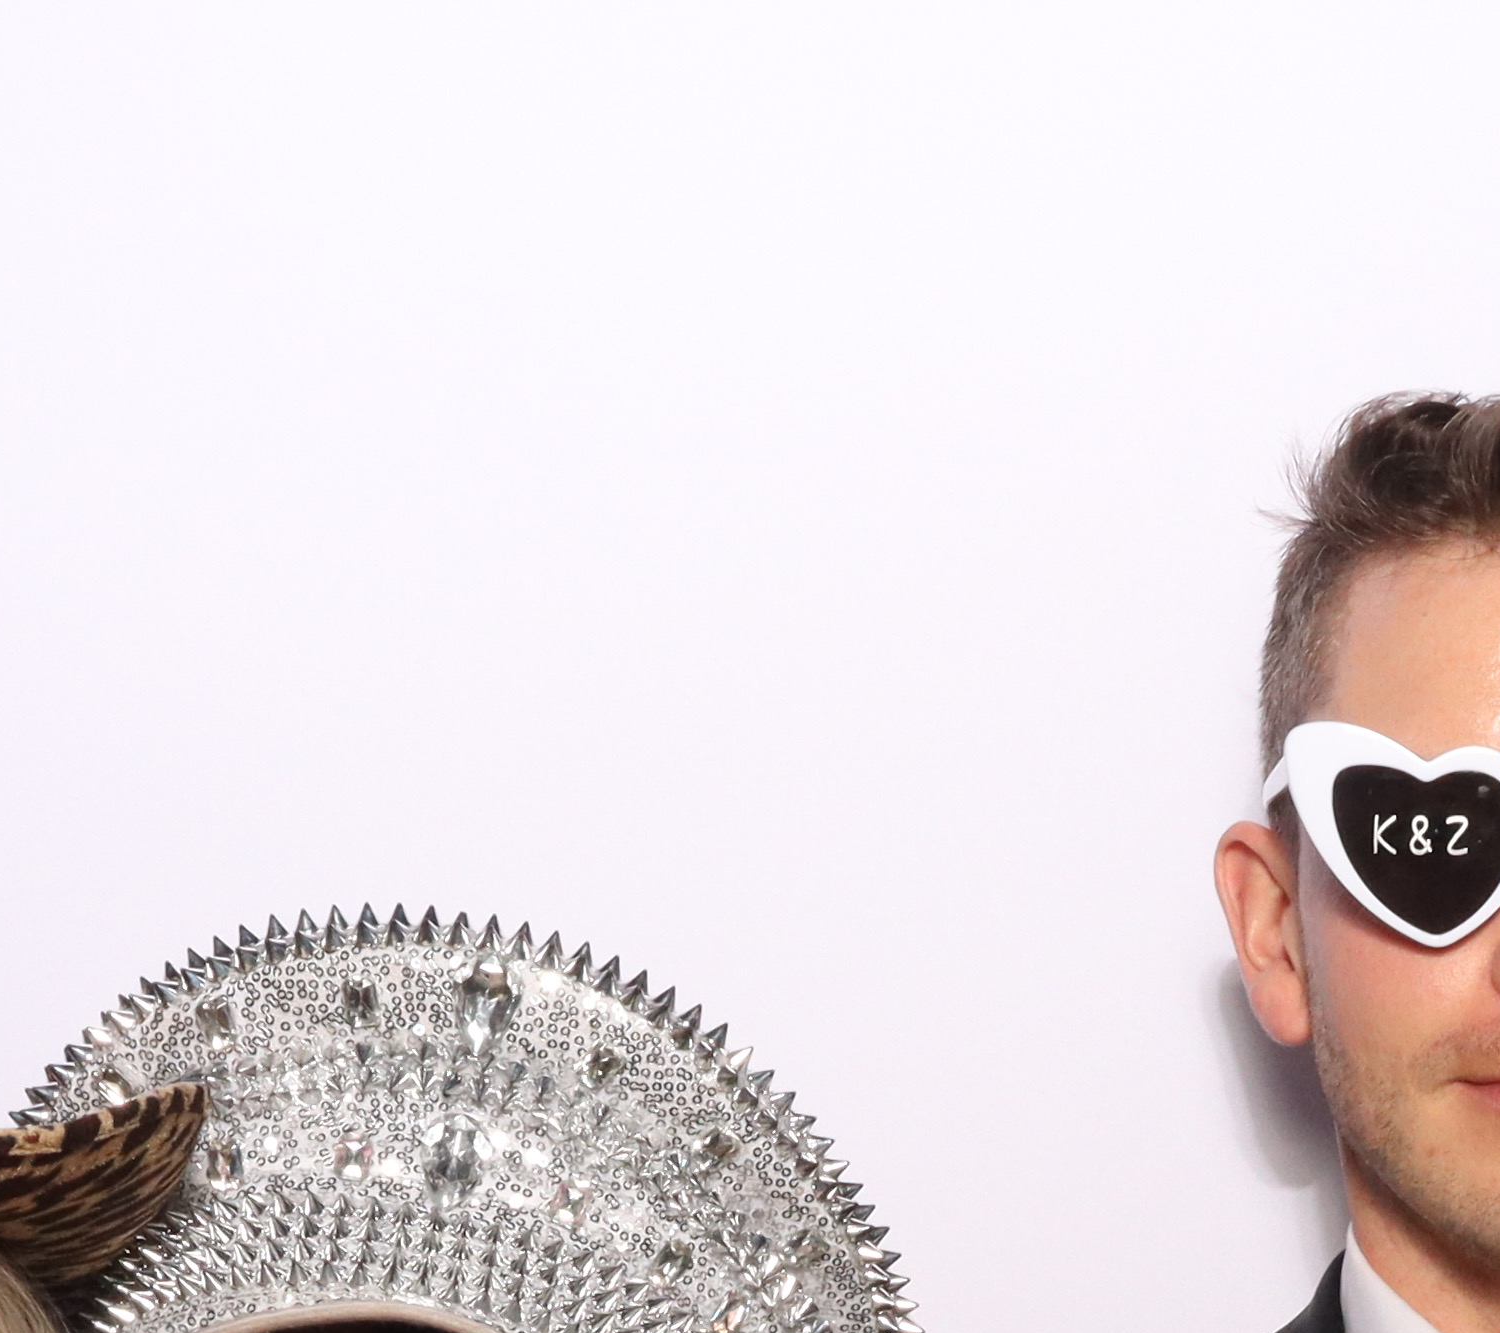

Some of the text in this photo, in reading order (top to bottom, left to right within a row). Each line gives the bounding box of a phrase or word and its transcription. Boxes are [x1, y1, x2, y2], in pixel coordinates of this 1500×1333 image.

[1373, 814, 1469, 856] K & Z
